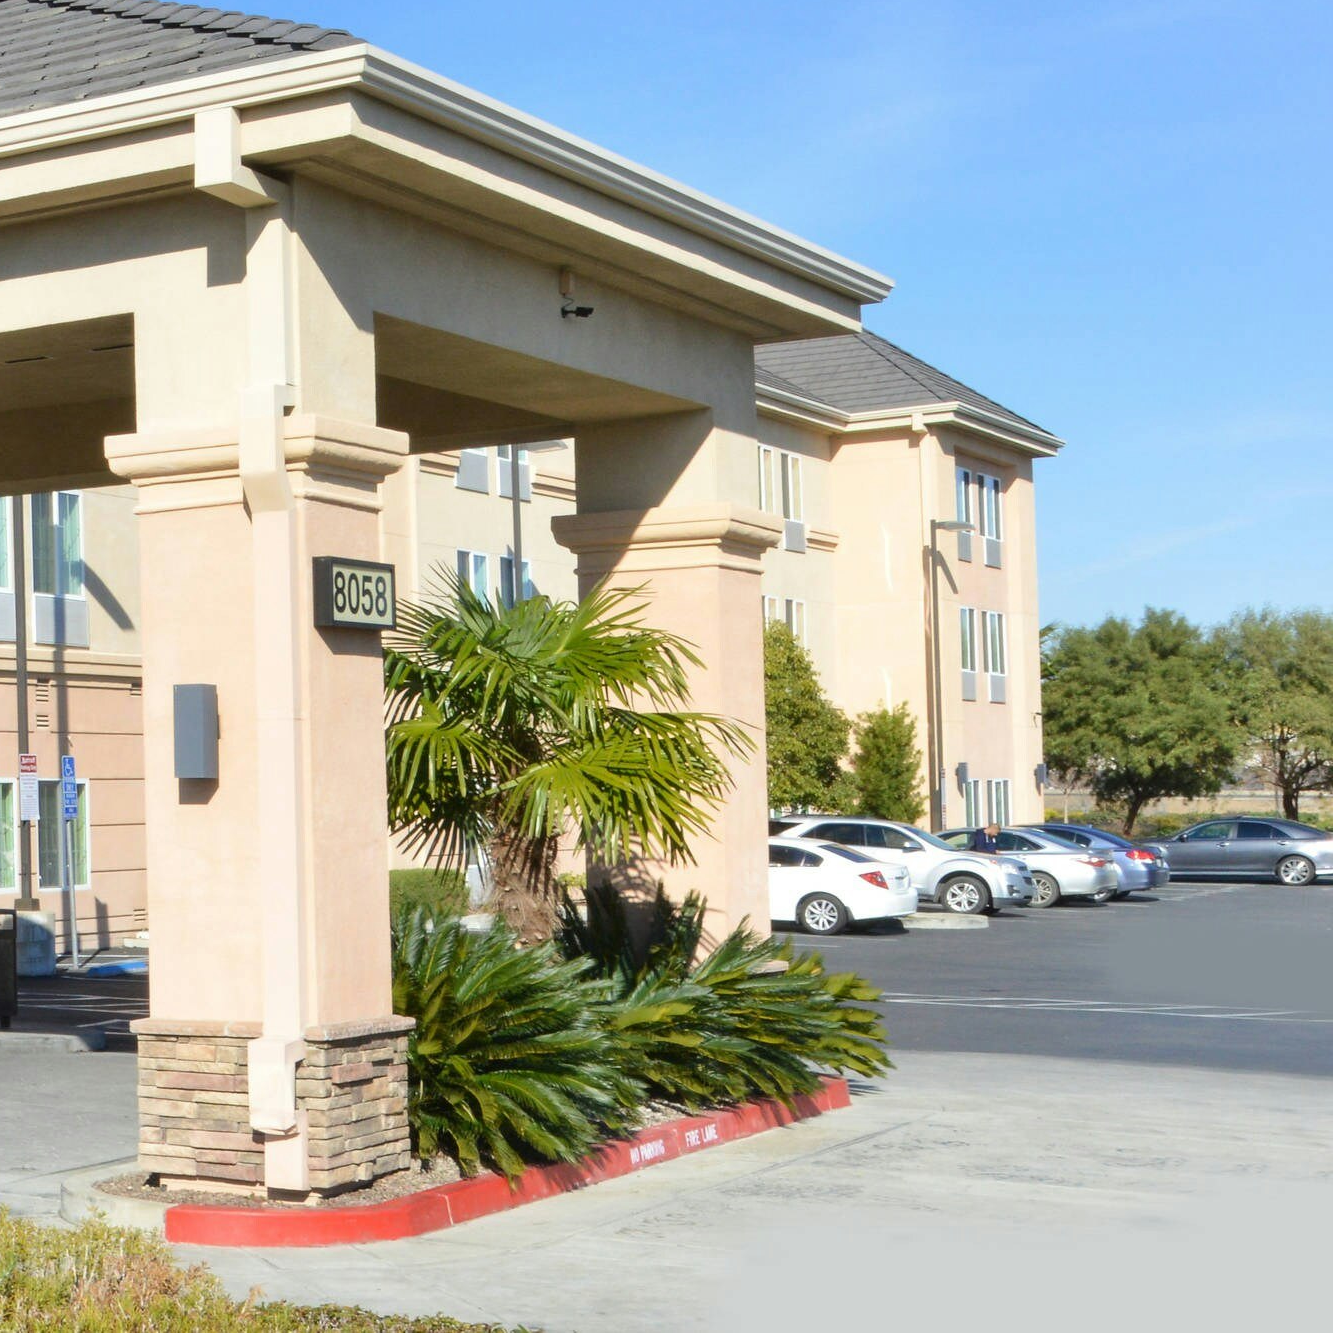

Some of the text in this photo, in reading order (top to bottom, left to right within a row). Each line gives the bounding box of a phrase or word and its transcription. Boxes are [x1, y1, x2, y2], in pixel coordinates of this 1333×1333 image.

[334, 571, 387, 617] 8058
[684, 1123, 718, 1147] FIRE LANE
[629, 1147, 640, 1164] NO
